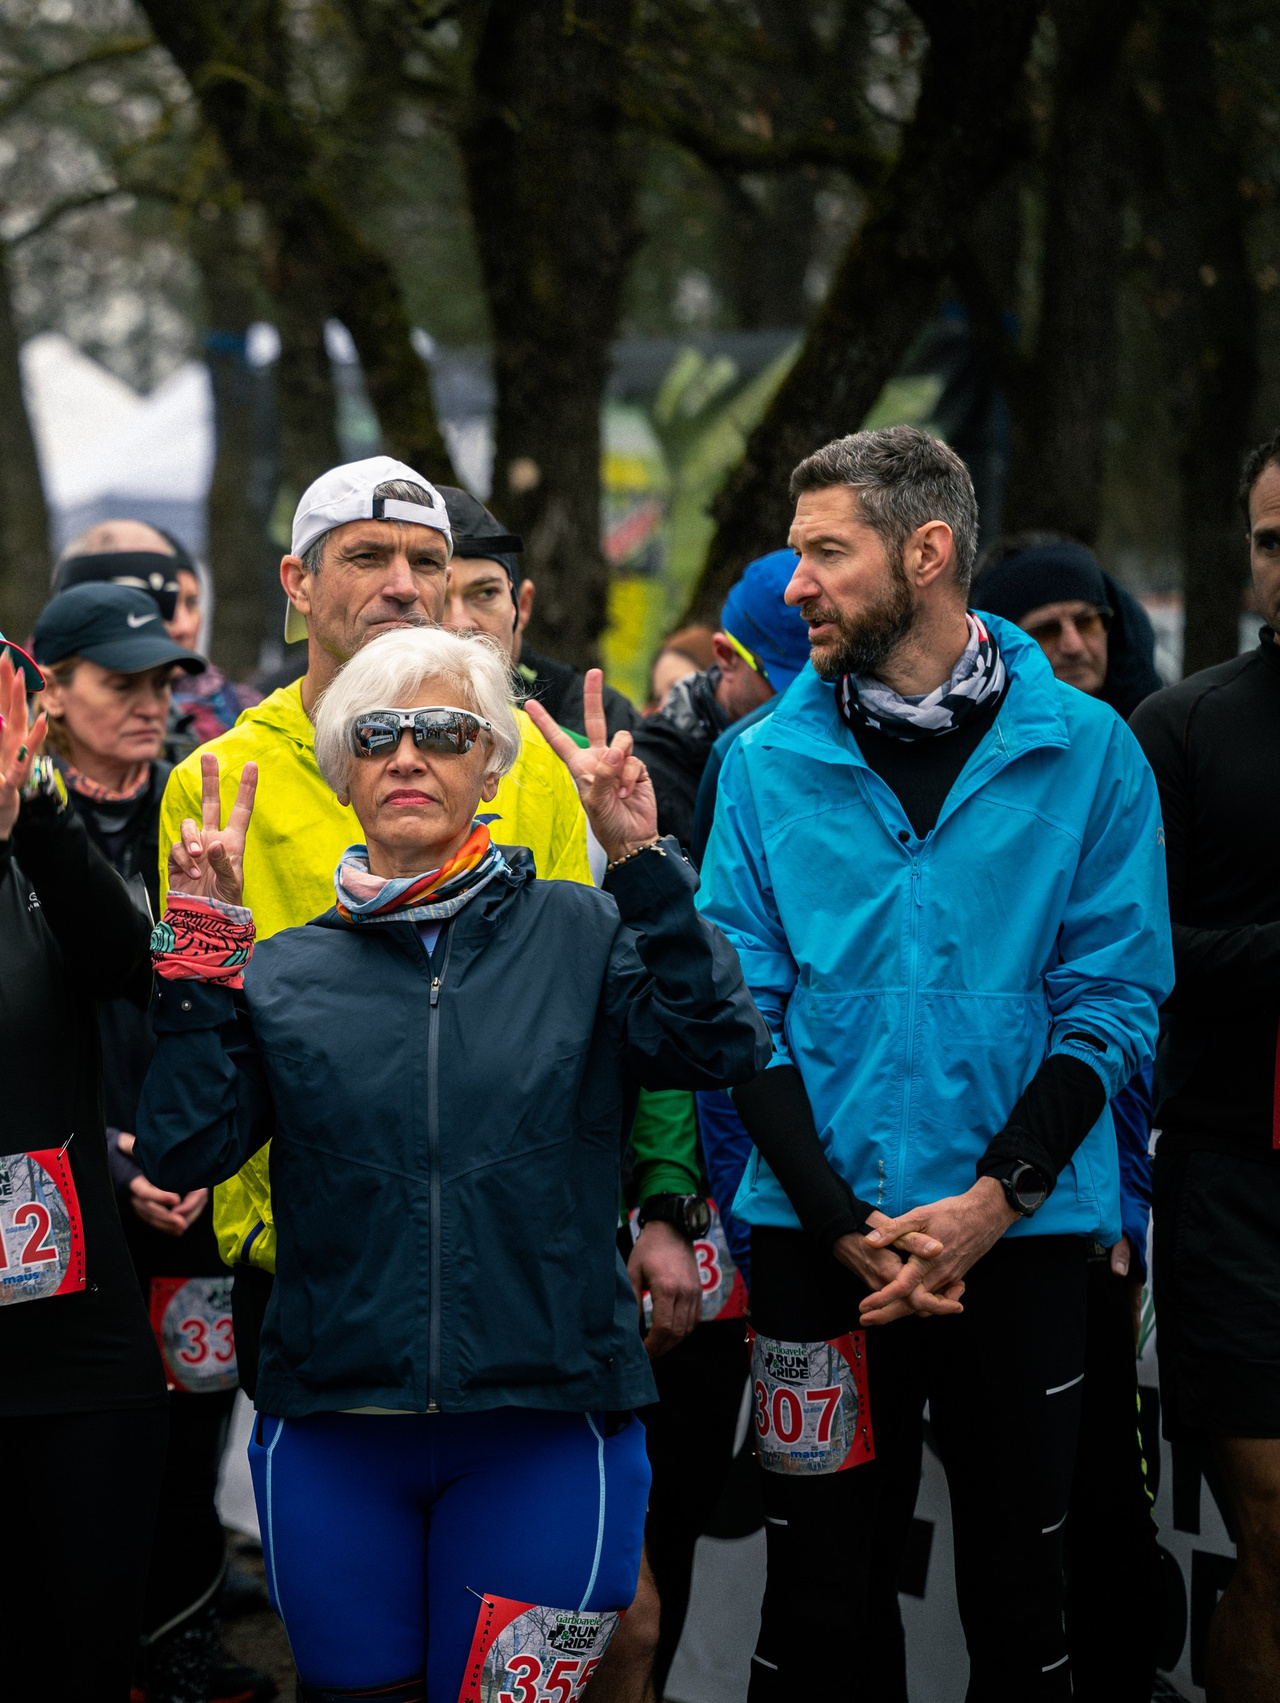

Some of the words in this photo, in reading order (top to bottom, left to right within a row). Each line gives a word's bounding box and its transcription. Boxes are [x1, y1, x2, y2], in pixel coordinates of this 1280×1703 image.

[693, 1240, 722, 1294] 3
[2, 1271, 40, 1285] maus
[772, 1359, 780, 1368] &
[776, 1354, 809, 1368] RUN
[777, 1368, 809, 1379] RIDE
[755, 1380, 843, 1444] 307
[790, 1450, 825, 1459] maus
[479, 1611, 493, 1653] TRAIL
[560, 1630, 570, 1641] &
[569, 1625, 600, 1637] RUN
[563, 1638, 594, 1649] RIDE
[470, 1663, 481, 1687] RUN
